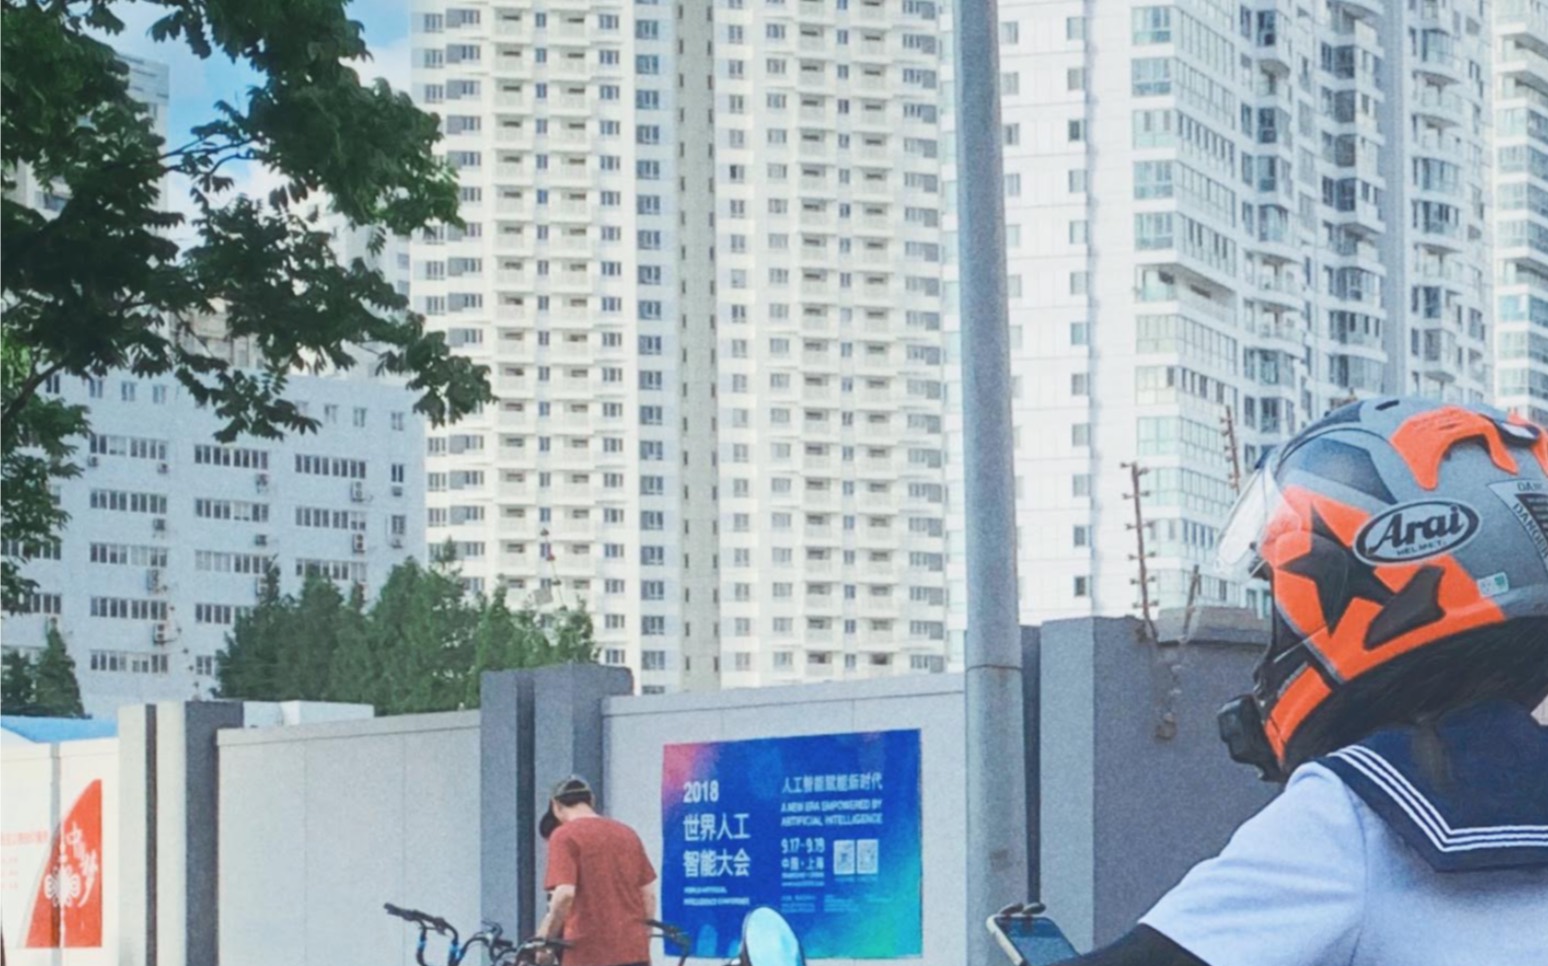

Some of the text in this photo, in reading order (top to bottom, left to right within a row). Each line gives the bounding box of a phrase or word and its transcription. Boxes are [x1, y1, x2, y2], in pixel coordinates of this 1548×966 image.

[1366, 505, 1465, 553] Arai
[683, 780, 719, 803] 2018
[683, 812, 752, 841] 世界人工
[683, 848, 752, 878] 智能大会
